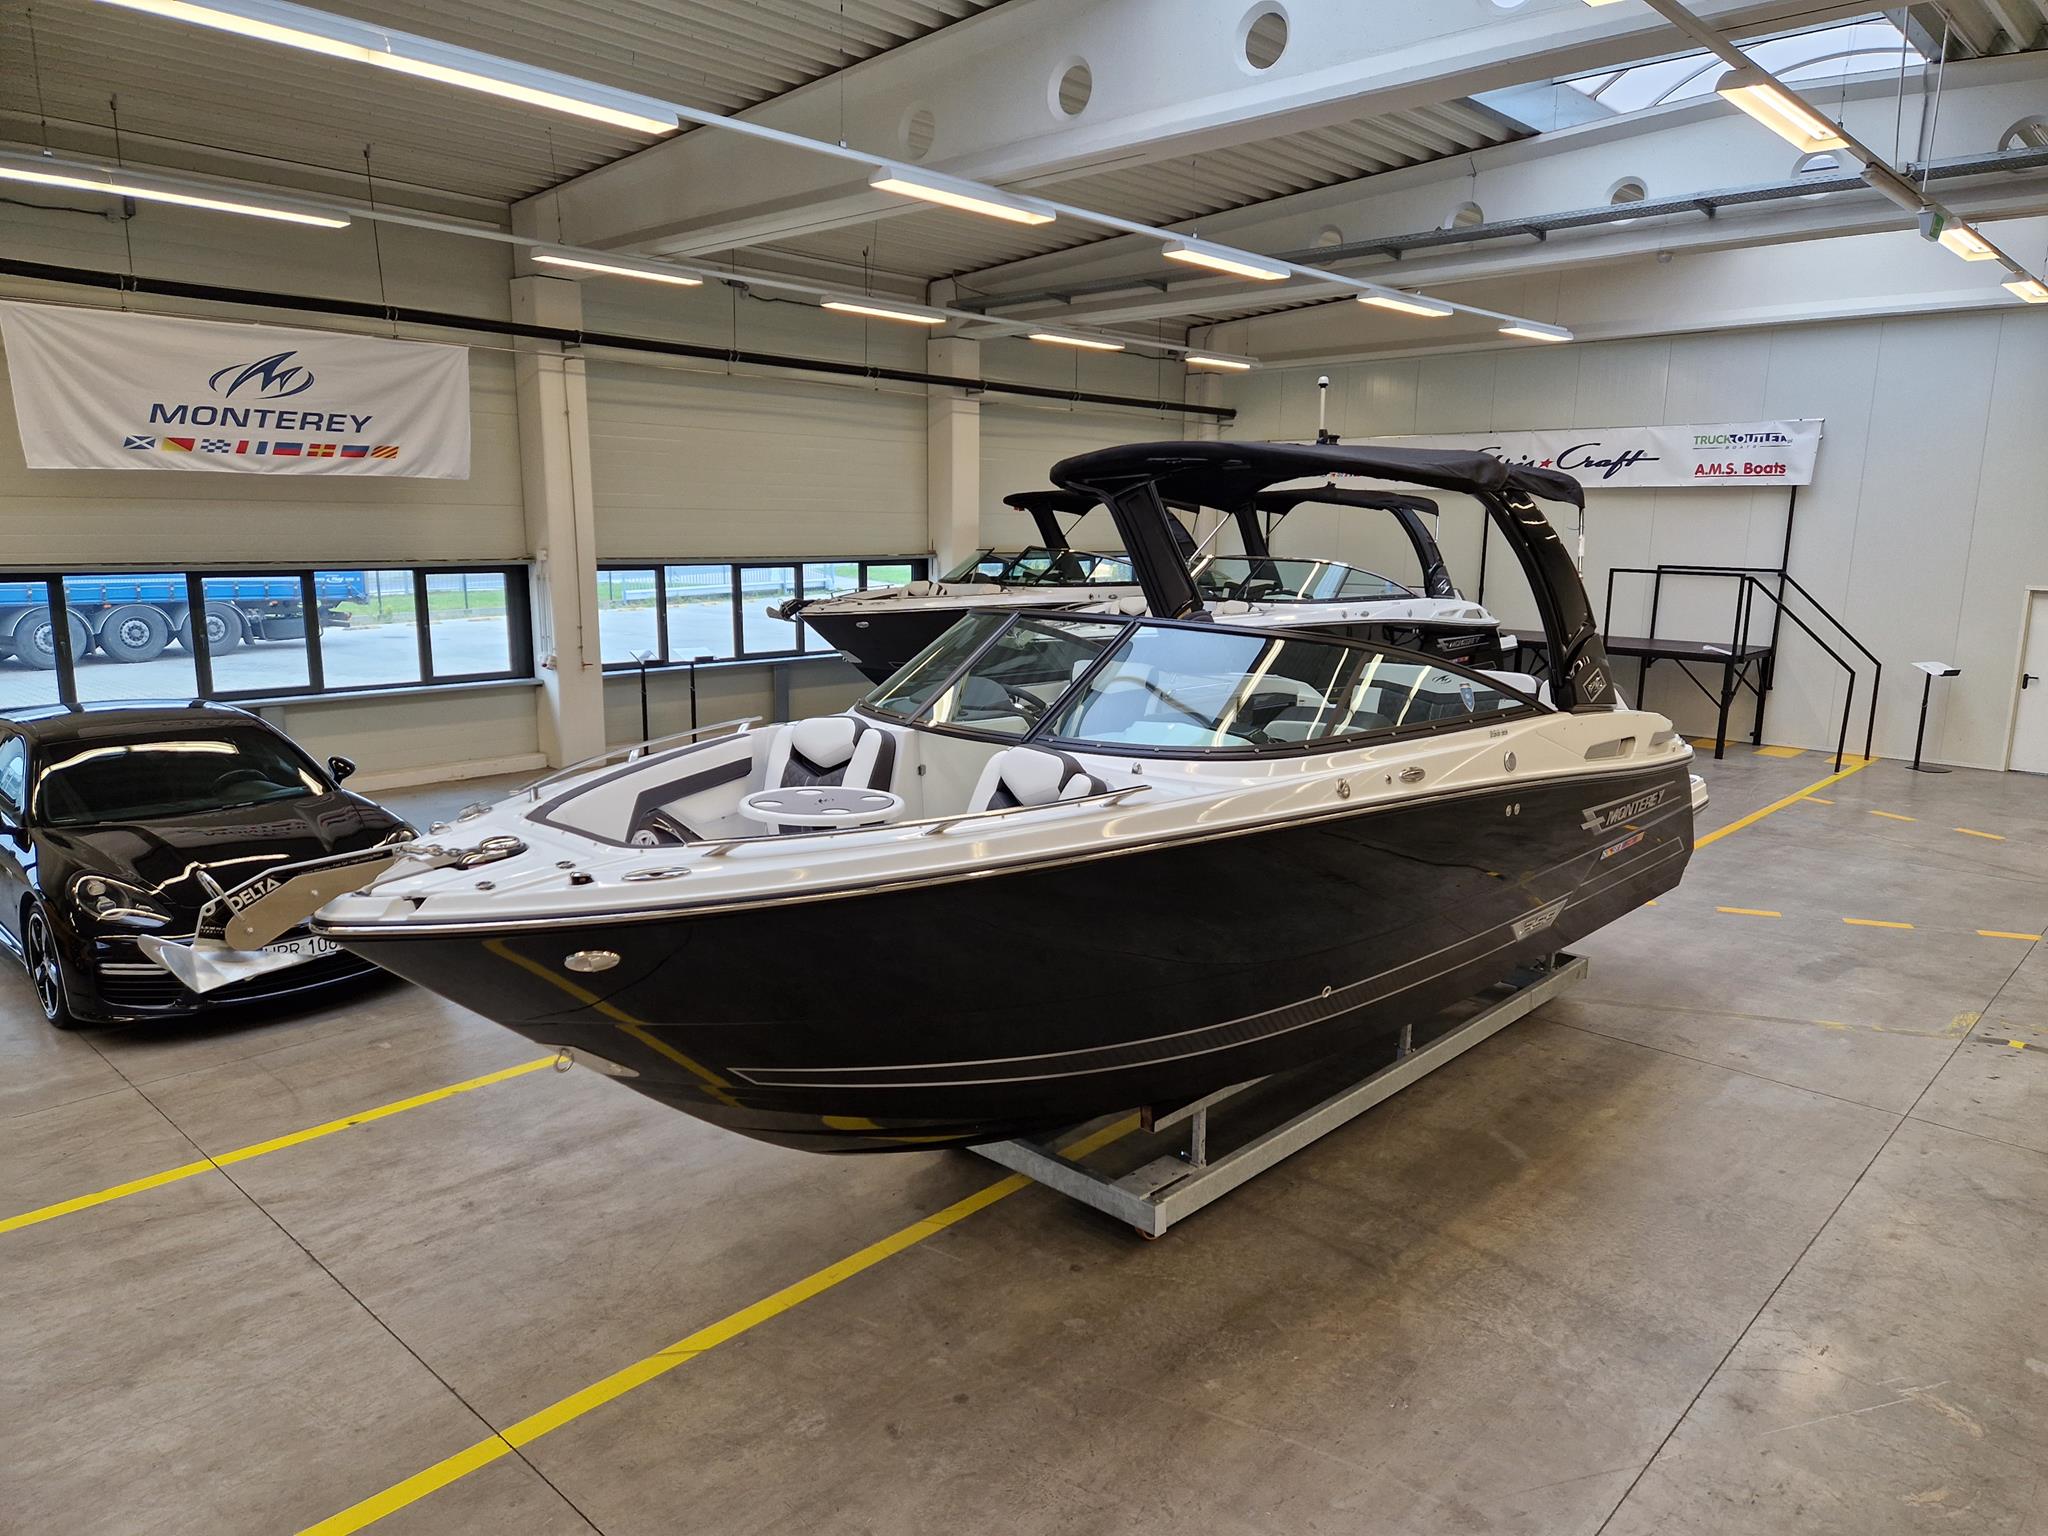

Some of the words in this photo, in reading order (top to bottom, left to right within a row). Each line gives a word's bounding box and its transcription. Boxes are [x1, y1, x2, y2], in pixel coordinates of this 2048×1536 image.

[149, 403, 373, 433] MONTEREY
[1695, 462, 1737, 475] A.M.S.
[1743, 462, 1786, 475] Boats
[1605, 789, 1666, 826] MONTEREY
[229, 877, 281, 910] DELTA
